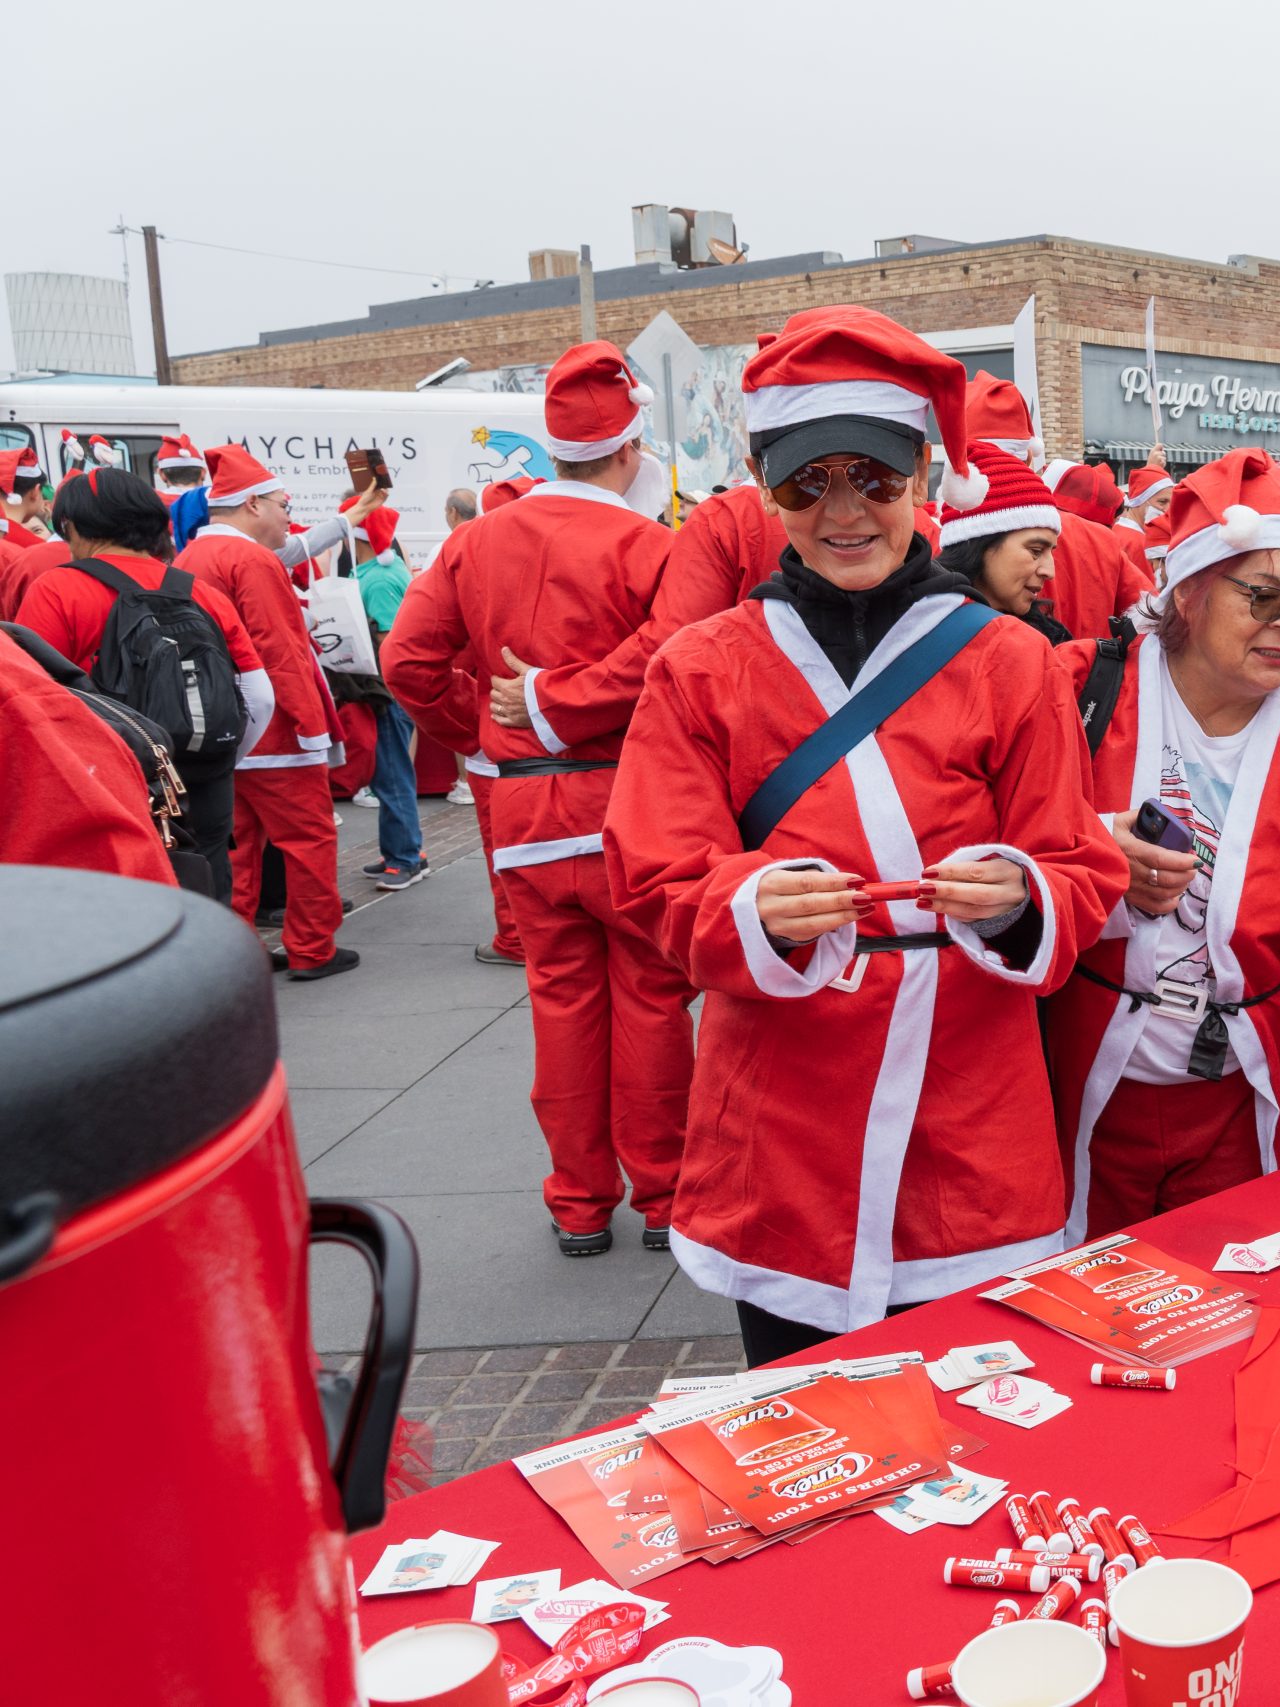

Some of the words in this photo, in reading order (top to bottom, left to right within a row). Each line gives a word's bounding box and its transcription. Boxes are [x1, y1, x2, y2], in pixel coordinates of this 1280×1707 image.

[1201, 412, 1235, 429] FISH
[1070, 1252, 1127, 1277] Cane's
[1137, 1285, 1199, 1314] Cane's
[1189, 1292, 1245, 1313] CHEERS
[1167, 1309, 1188, 1318] TO
[1134, 1316, 1167, 1331] YOU!
[1167, 1325, 1187, 1335] TO
[1138, 1333, 1168, 1349] YOU!
[718, 1400, 744, 1412] FREE
[659, 1416, 693, 1430] DRINK
[718, 1400, 795, 1438] Cane's
[599, 1437, 627, 1452] FREE
[533, 1452, 571, 1470] DRINK
[593, 1446, 644, 1480] ne's
[779, 1453, 866, 1498] Cane's
[846, 1462, 922, 1495] CHEERS
[643, 1494, 668, 1504] U!
[815, 1491, 842, 1504] TO
[767, 1501, 813, 1523] YOU!
[1062, 1511, 1074, 1527] LIP
[1068, 1522, 1086, 1547] SAUCE
[630, 1551, 679, 1576] YOU!
[958, 1557, 998, 1568] SAUCE
[1035, 1551, 1070, 1564] Cane's
[1001, 1561, 1023, 1571] LIP
[1050, 1567, 1083, 1579] AUCE
[1087, 1612, 1099, 1627] LIP
[677, 1641, 711, 1650] RAISING
